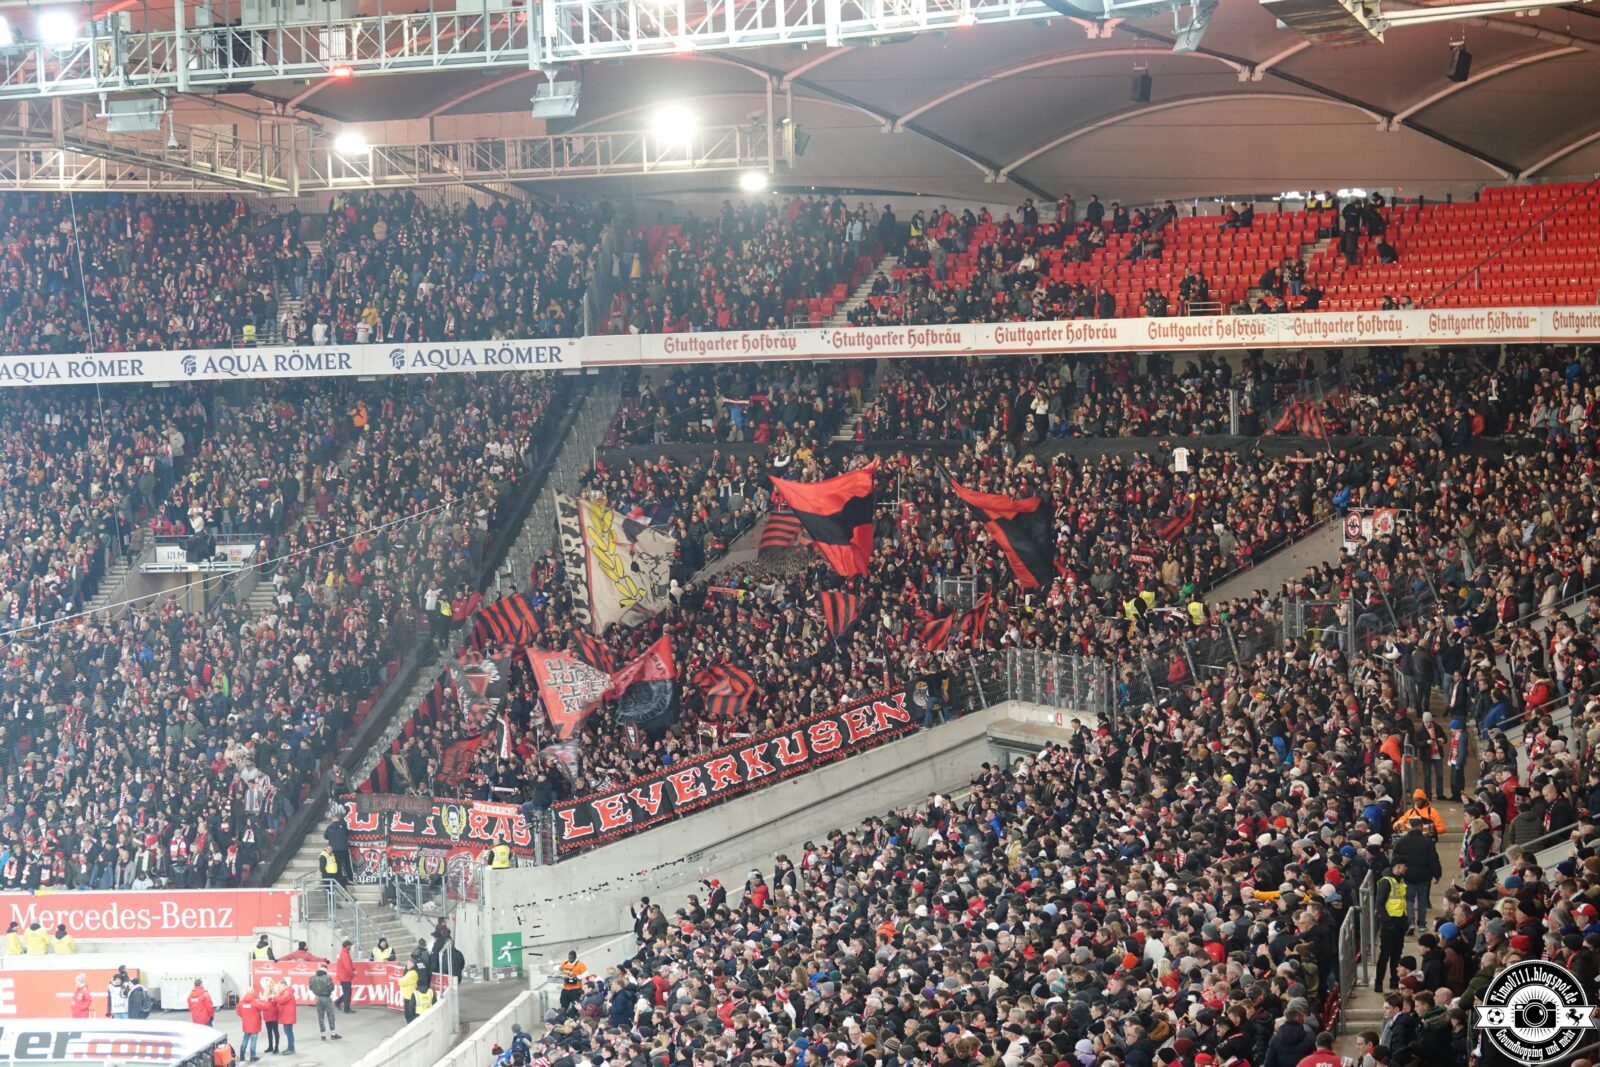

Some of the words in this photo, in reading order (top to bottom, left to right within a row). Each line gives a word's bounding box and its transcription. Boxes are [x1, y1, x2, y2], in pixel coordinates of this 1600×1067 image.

[994, 326, 1062, 346] Stuttgarter
[1066, 322, 1117, 343] Hofbräu
[1148, 321, 1213, 342] Stuttgarter
[1293, 316, 1354, 337] Stuttgarter
[1429, 313, 1485, 335] Stuttgarter
[664, 333, 738, 355] Stuttgarter
[832, 329, 905, 351] Stuttgarter
[908, 328, 961, 349] Hofbräu
[203, 355, 270, 376] AQUA
[274, 350, 352, 373] RÖMER
[411, 347, 477, 370] AQUA
[484, 343, 563, 365] RÖMER
[0, 361, 61, 382] AQUA
[68, 356, 144, 380] RÖMER
[558, 692, 911, 841] LEVERKUSEN
[10, 901, 233, 932] Mercedes-Benz
